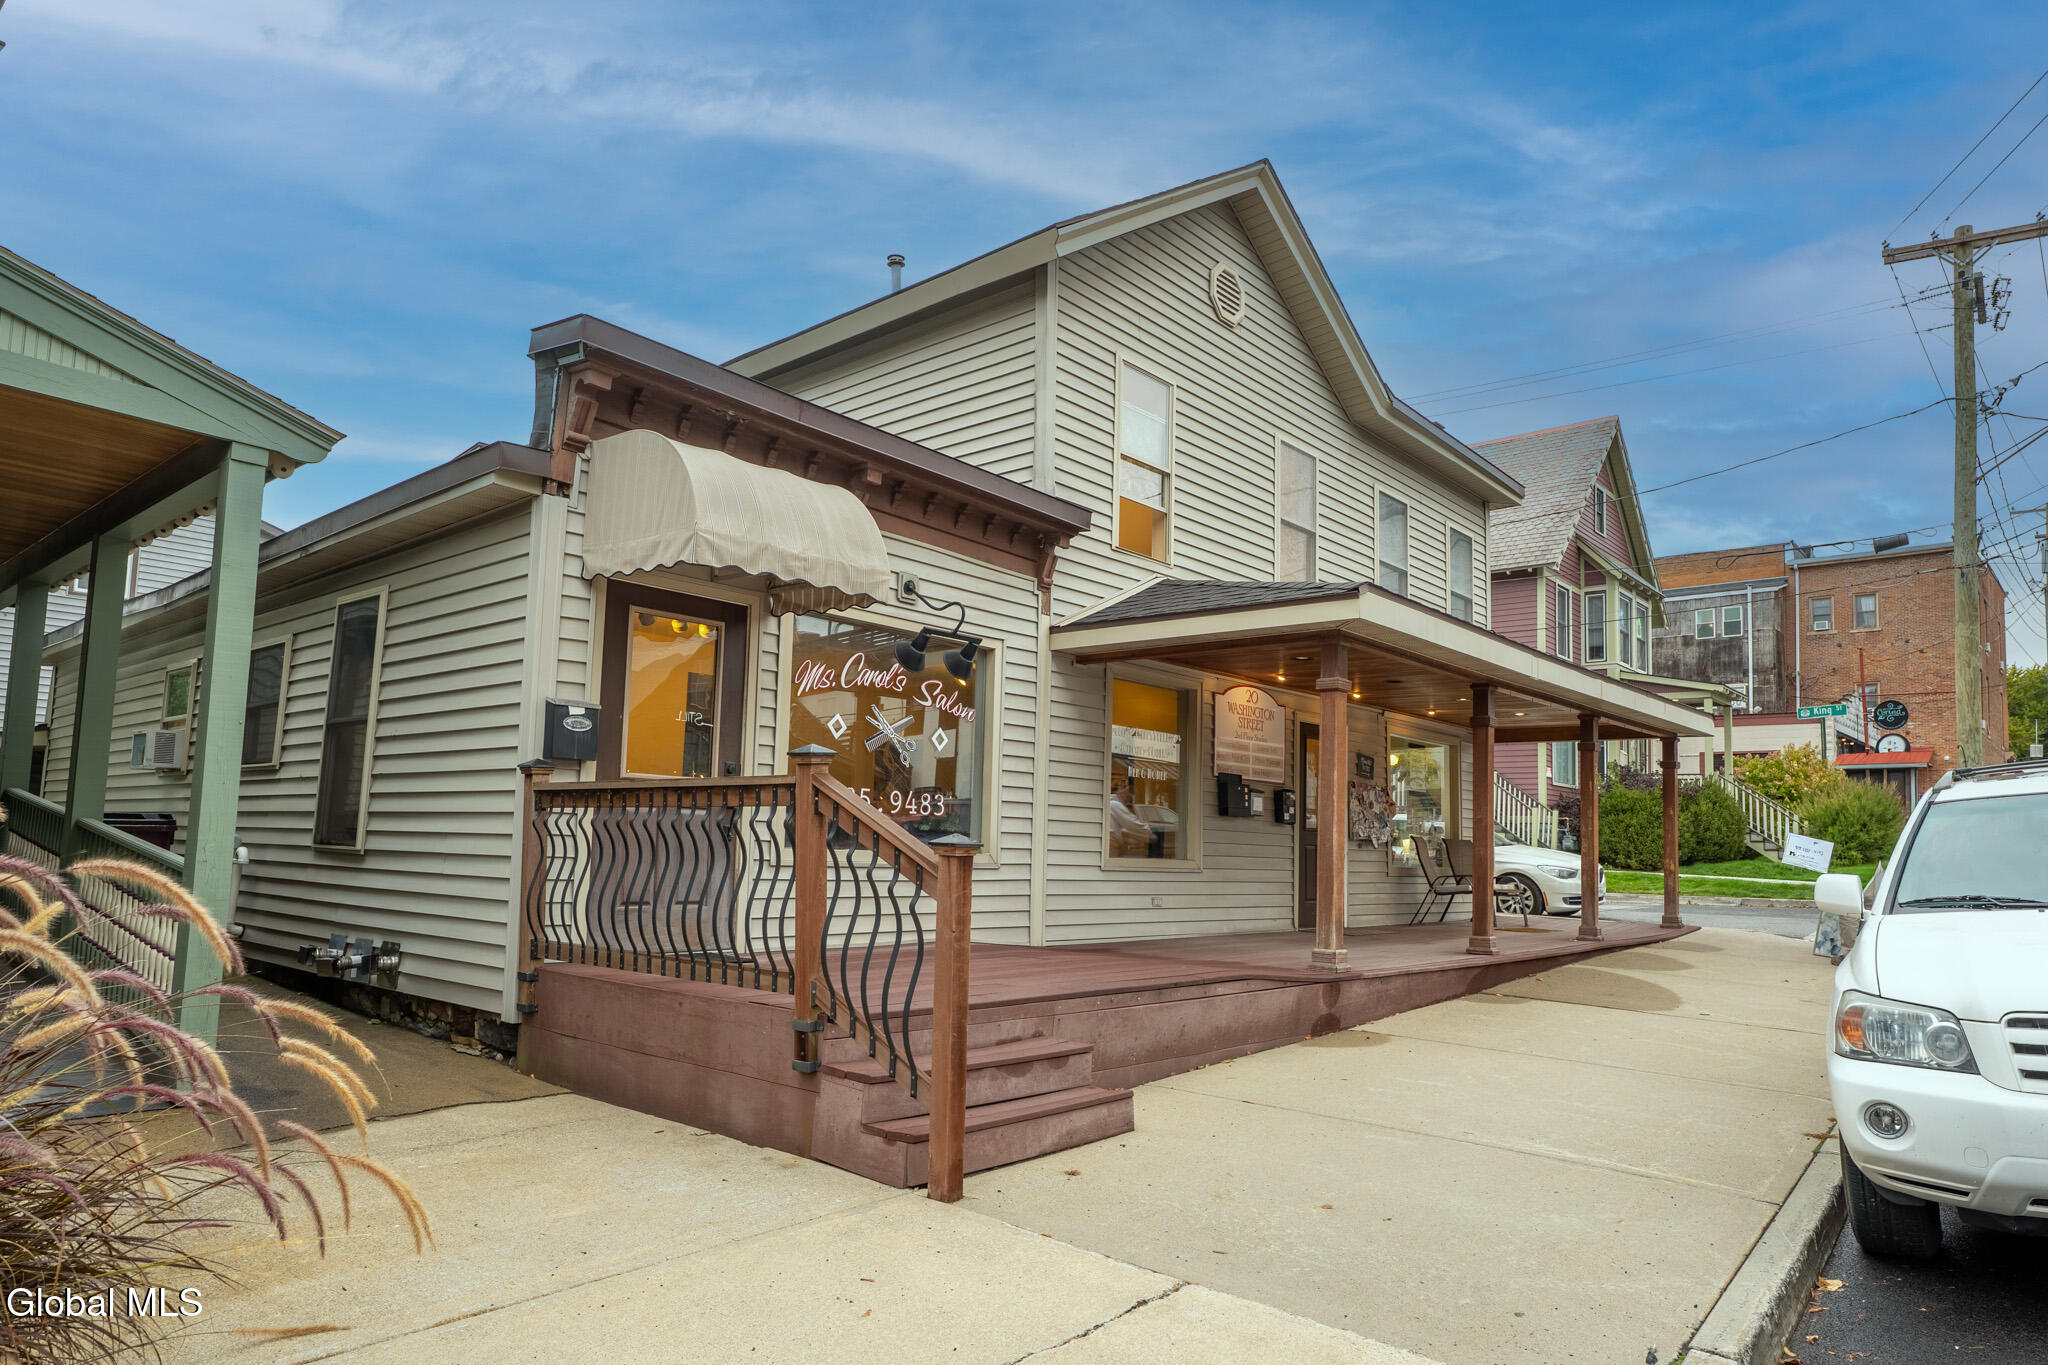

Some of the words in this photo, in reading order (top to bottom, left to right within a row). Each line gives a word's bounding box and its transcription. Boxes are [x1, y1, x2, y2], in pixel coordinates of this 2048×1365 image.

[795, 659, 836, 696] Ms.
[840, 652, 907, 692] Carol's
[912, 680, 976, 722] Salon
[1245, 690, 1259, 704] 20
[1226, 701, 1276, 721] WASHINGTON
[1813, 707, 1832, 717] King
[1238, 716, 1264, 732] STREET
